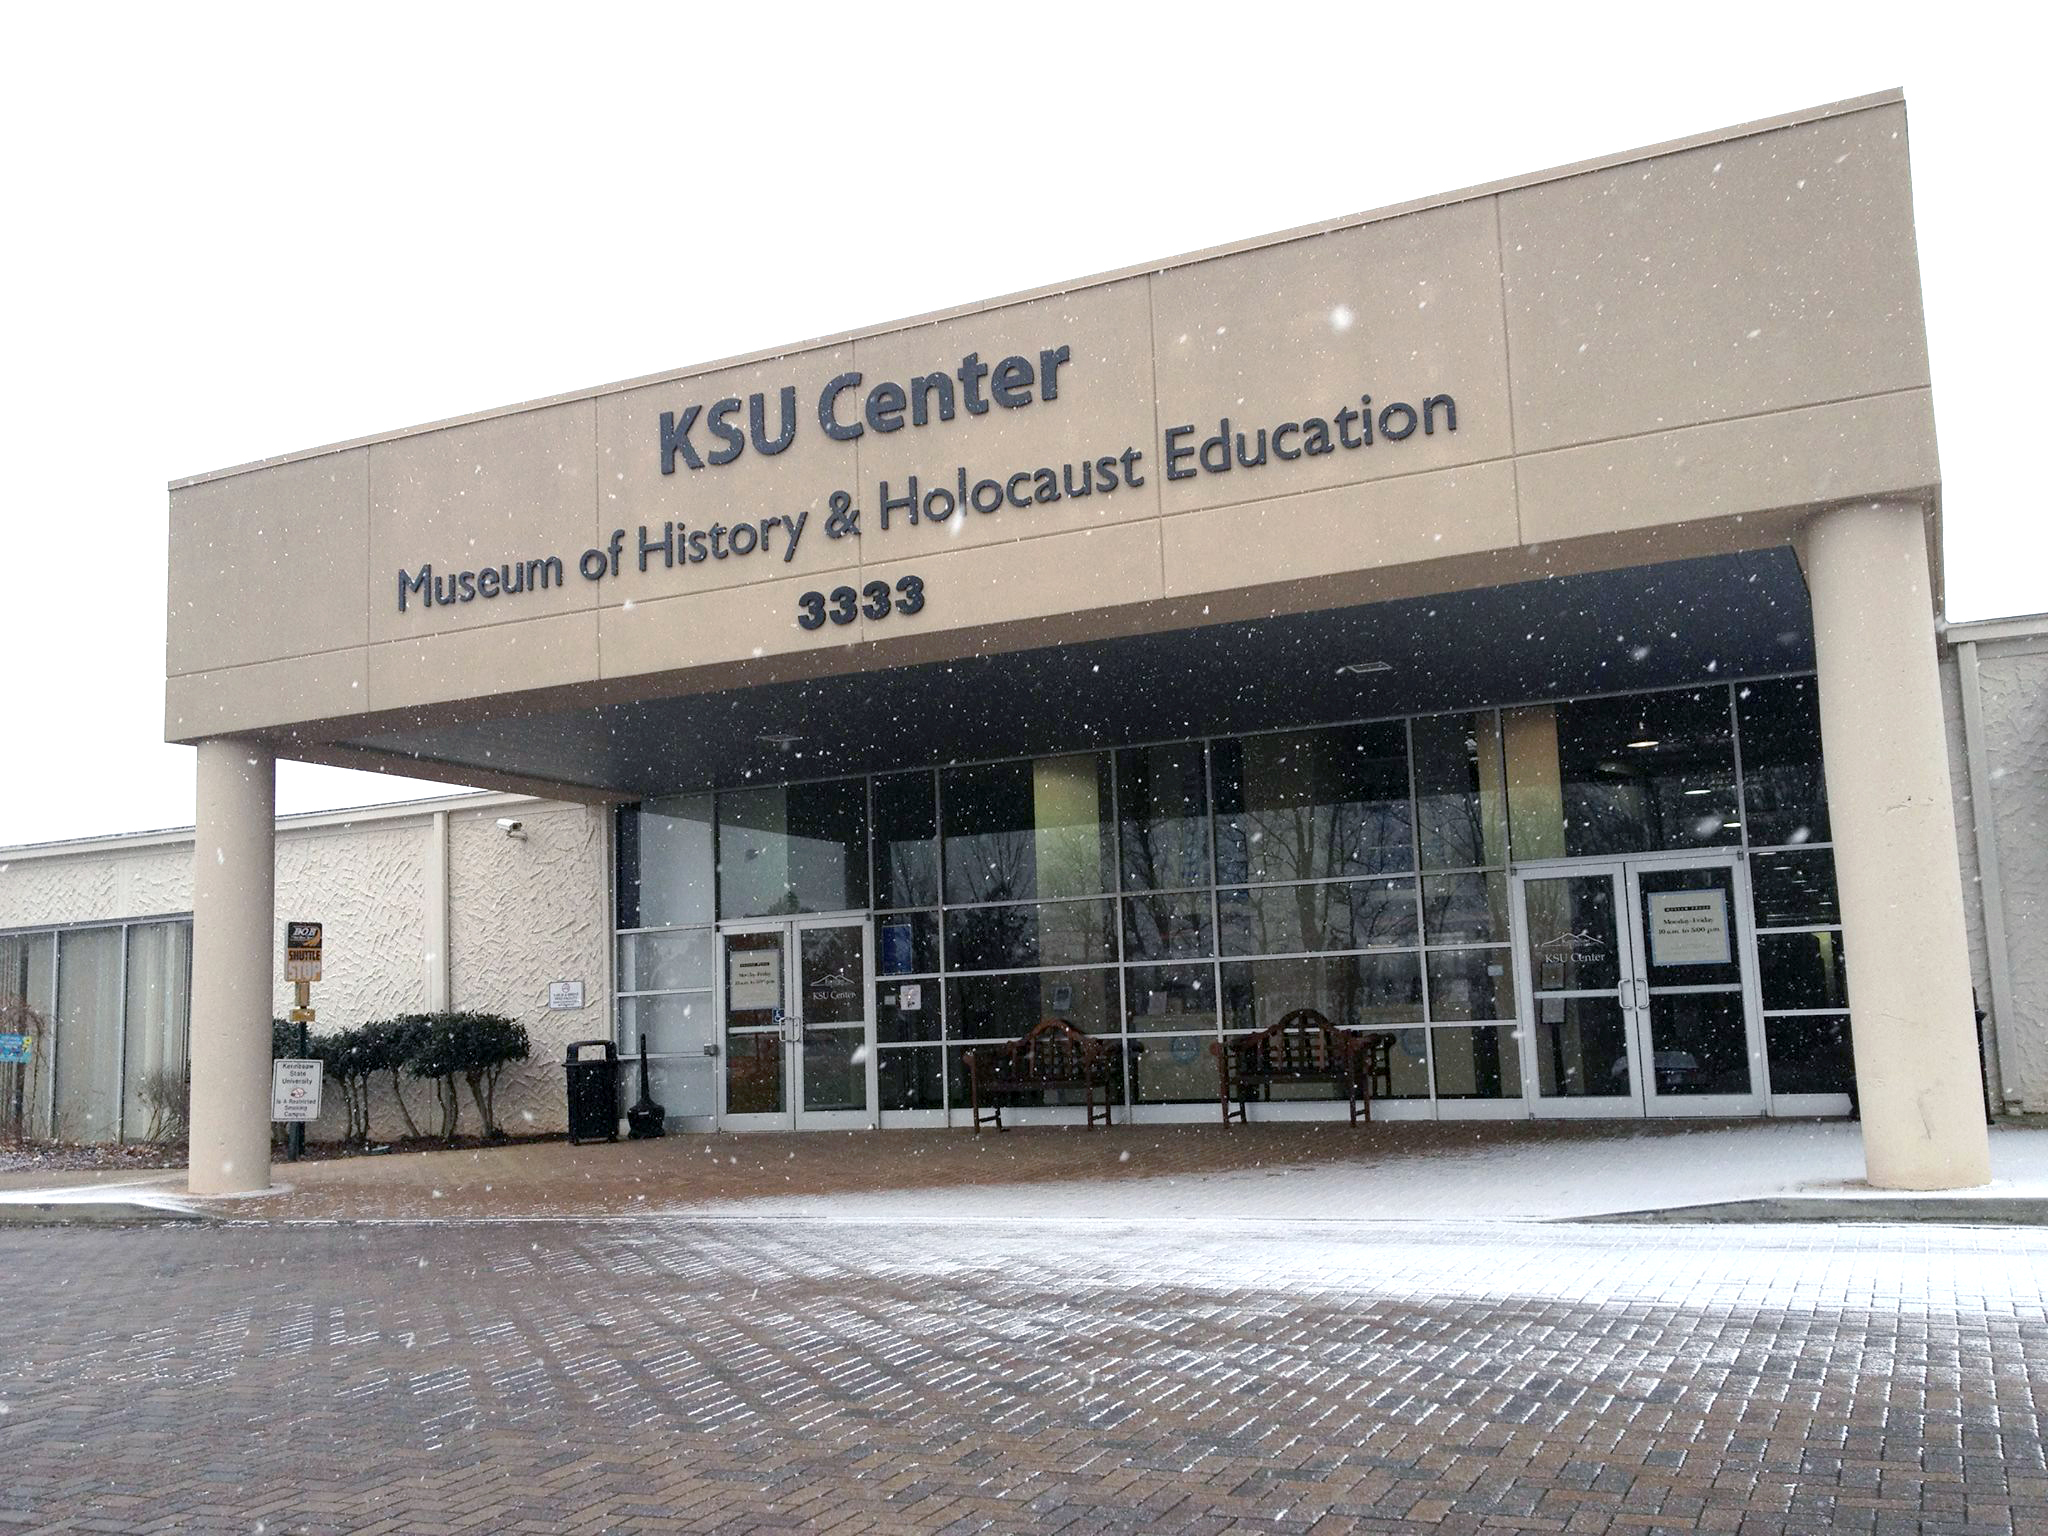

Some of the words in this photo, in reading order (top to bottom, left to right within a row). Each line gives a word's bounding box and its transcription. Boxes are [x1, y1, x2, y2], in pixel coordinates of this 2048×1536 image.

[659, 386, 797, 475] KSU
[818, 345, 1070, 441] Center
[398, 556, 563, 613] Museum
[580, 529, 626, 583] of
[638, 511, 809, 572] History
[824, 490, 862, 540] &
[880, 446, 1145, 531] Holocaust
[1165, 394, 1457, 482] Education
[797, 574, 926, 631] 3333
[288, 950, 321, 961] SHUTTLE
[1545, 953, 1568, 963] KSU
[1570, 952, 1606, 963] Center
[813, 991, 829, 1000] KSU
[830, 991, 857, 1000] Center
